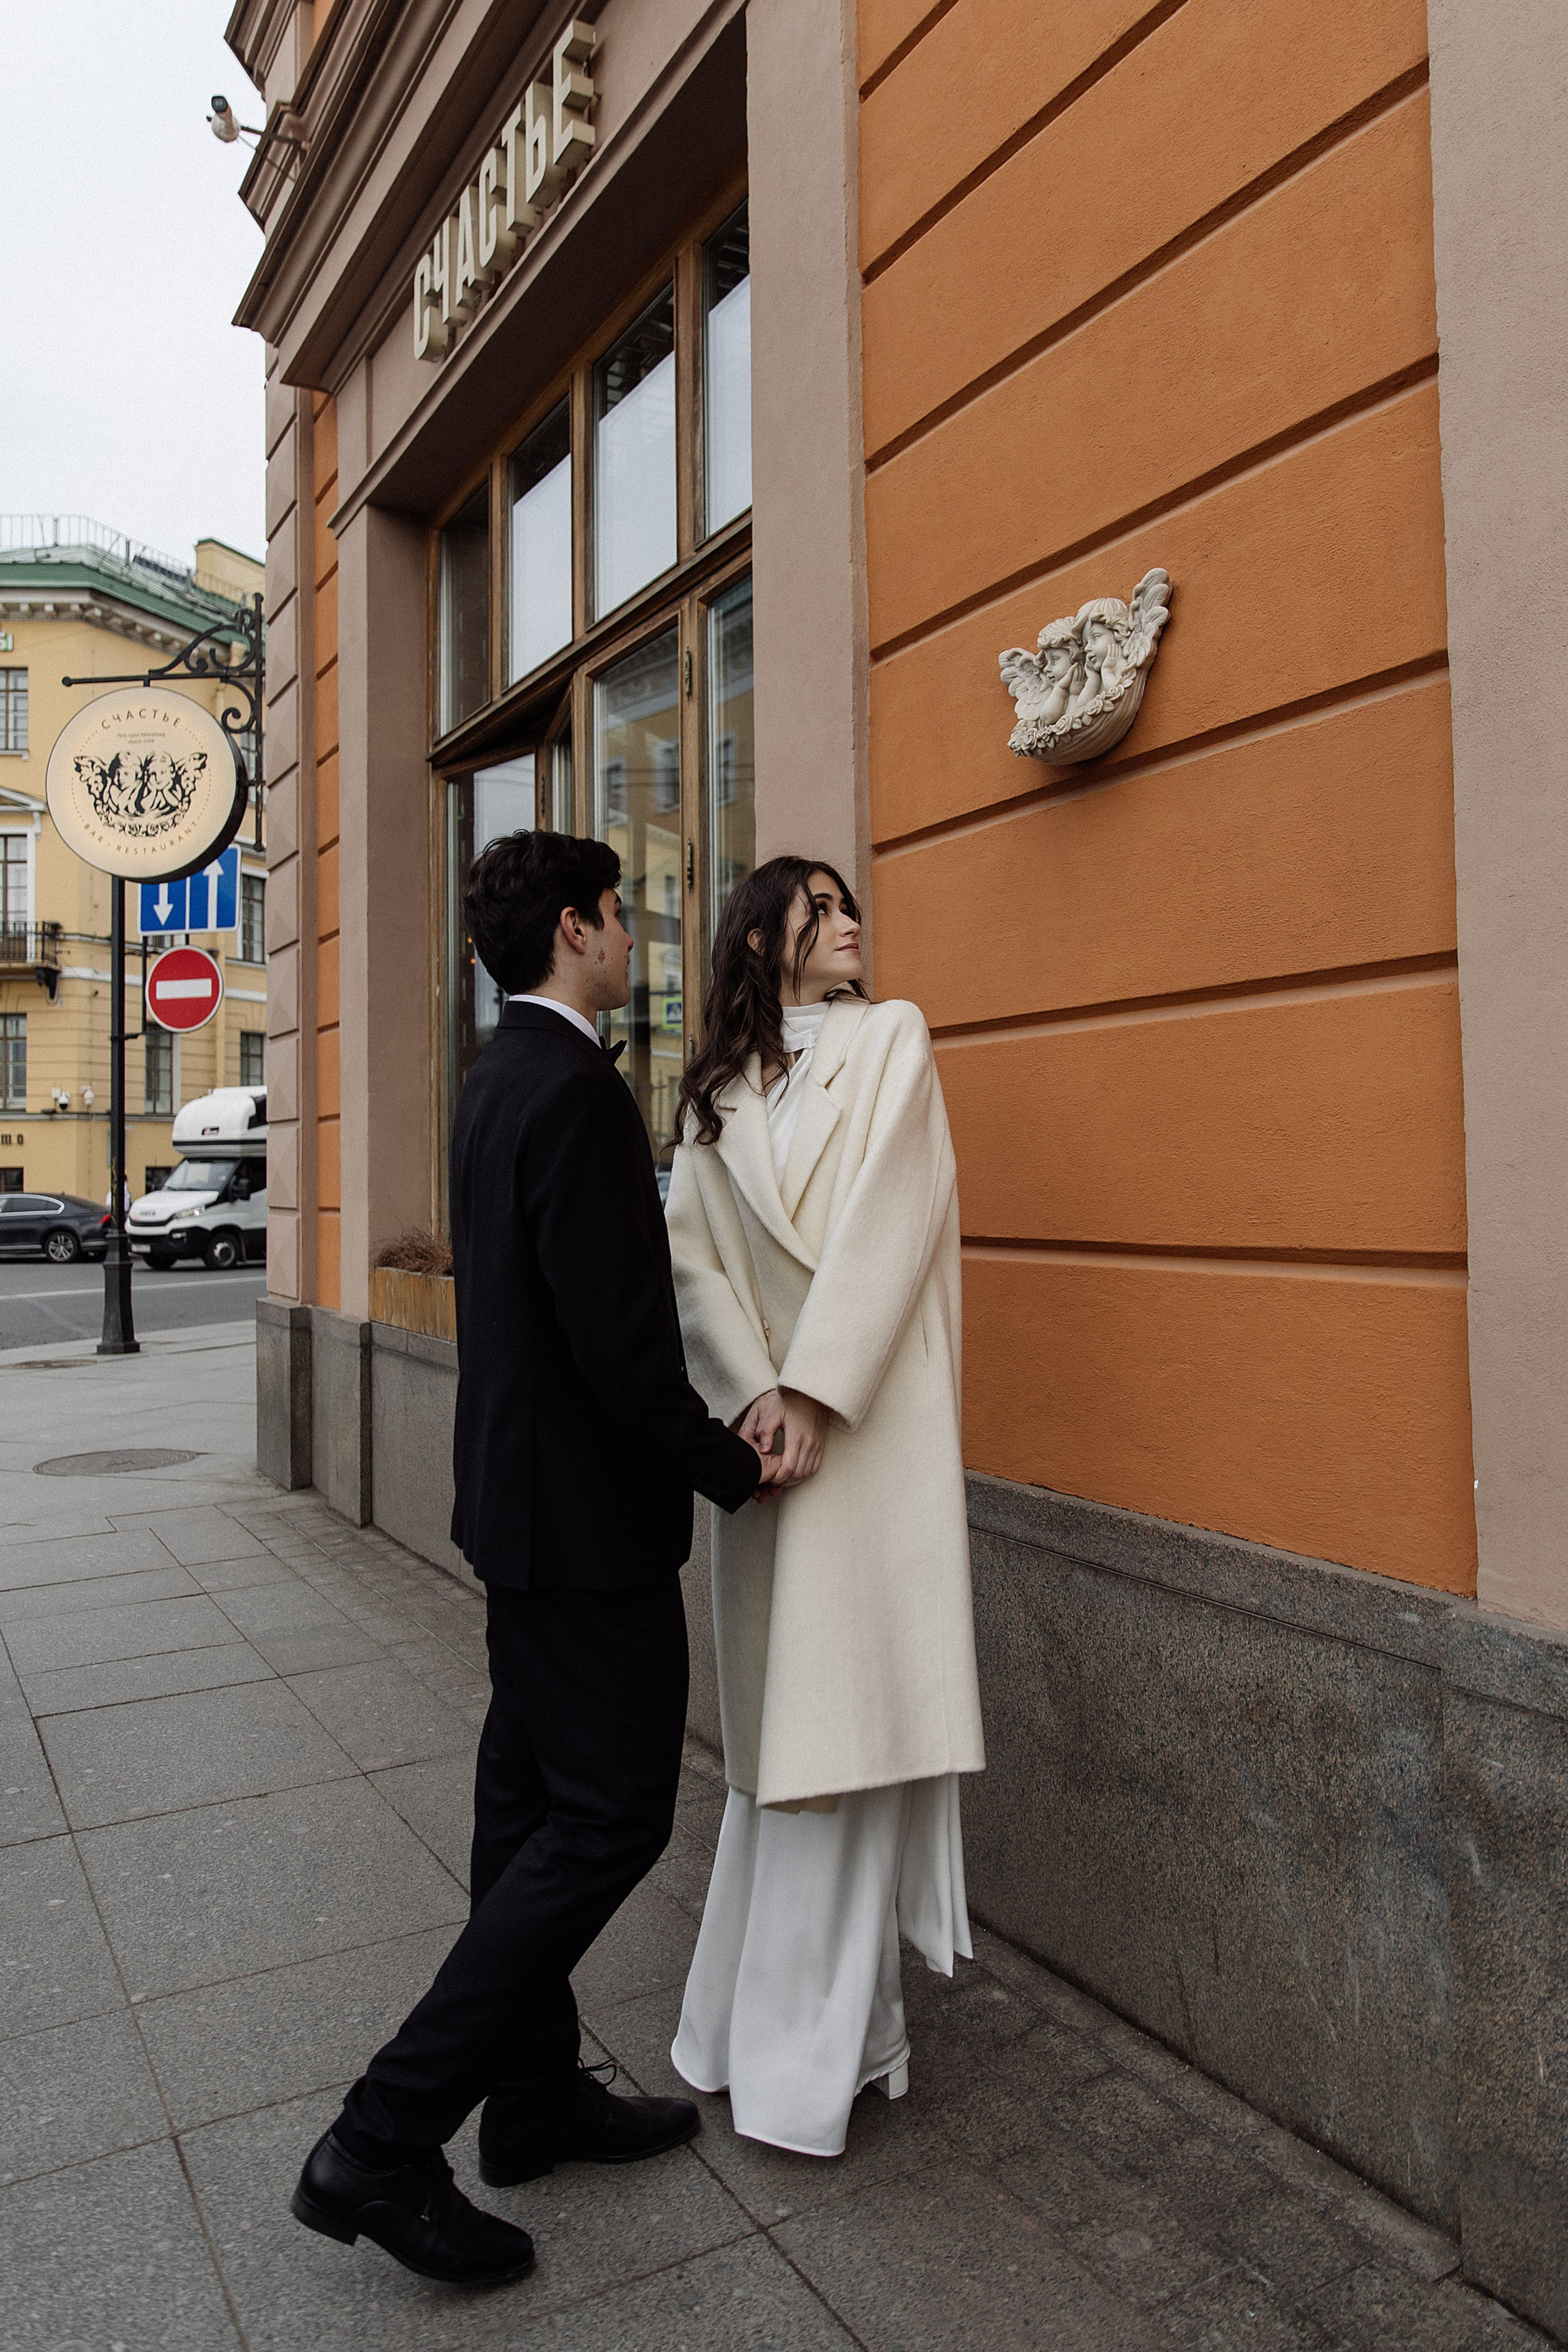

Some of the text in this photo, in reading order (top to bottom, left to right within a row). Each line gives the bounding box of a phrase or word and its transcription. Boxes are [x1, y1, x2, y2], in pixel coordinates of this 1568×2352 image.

[413, 20, 595, 363] СЧАСТЬЕ
[101, 707, 181, 729] СЧАСТЬЕ
[84, 821, 198, 854] BAR RESTAURANT
